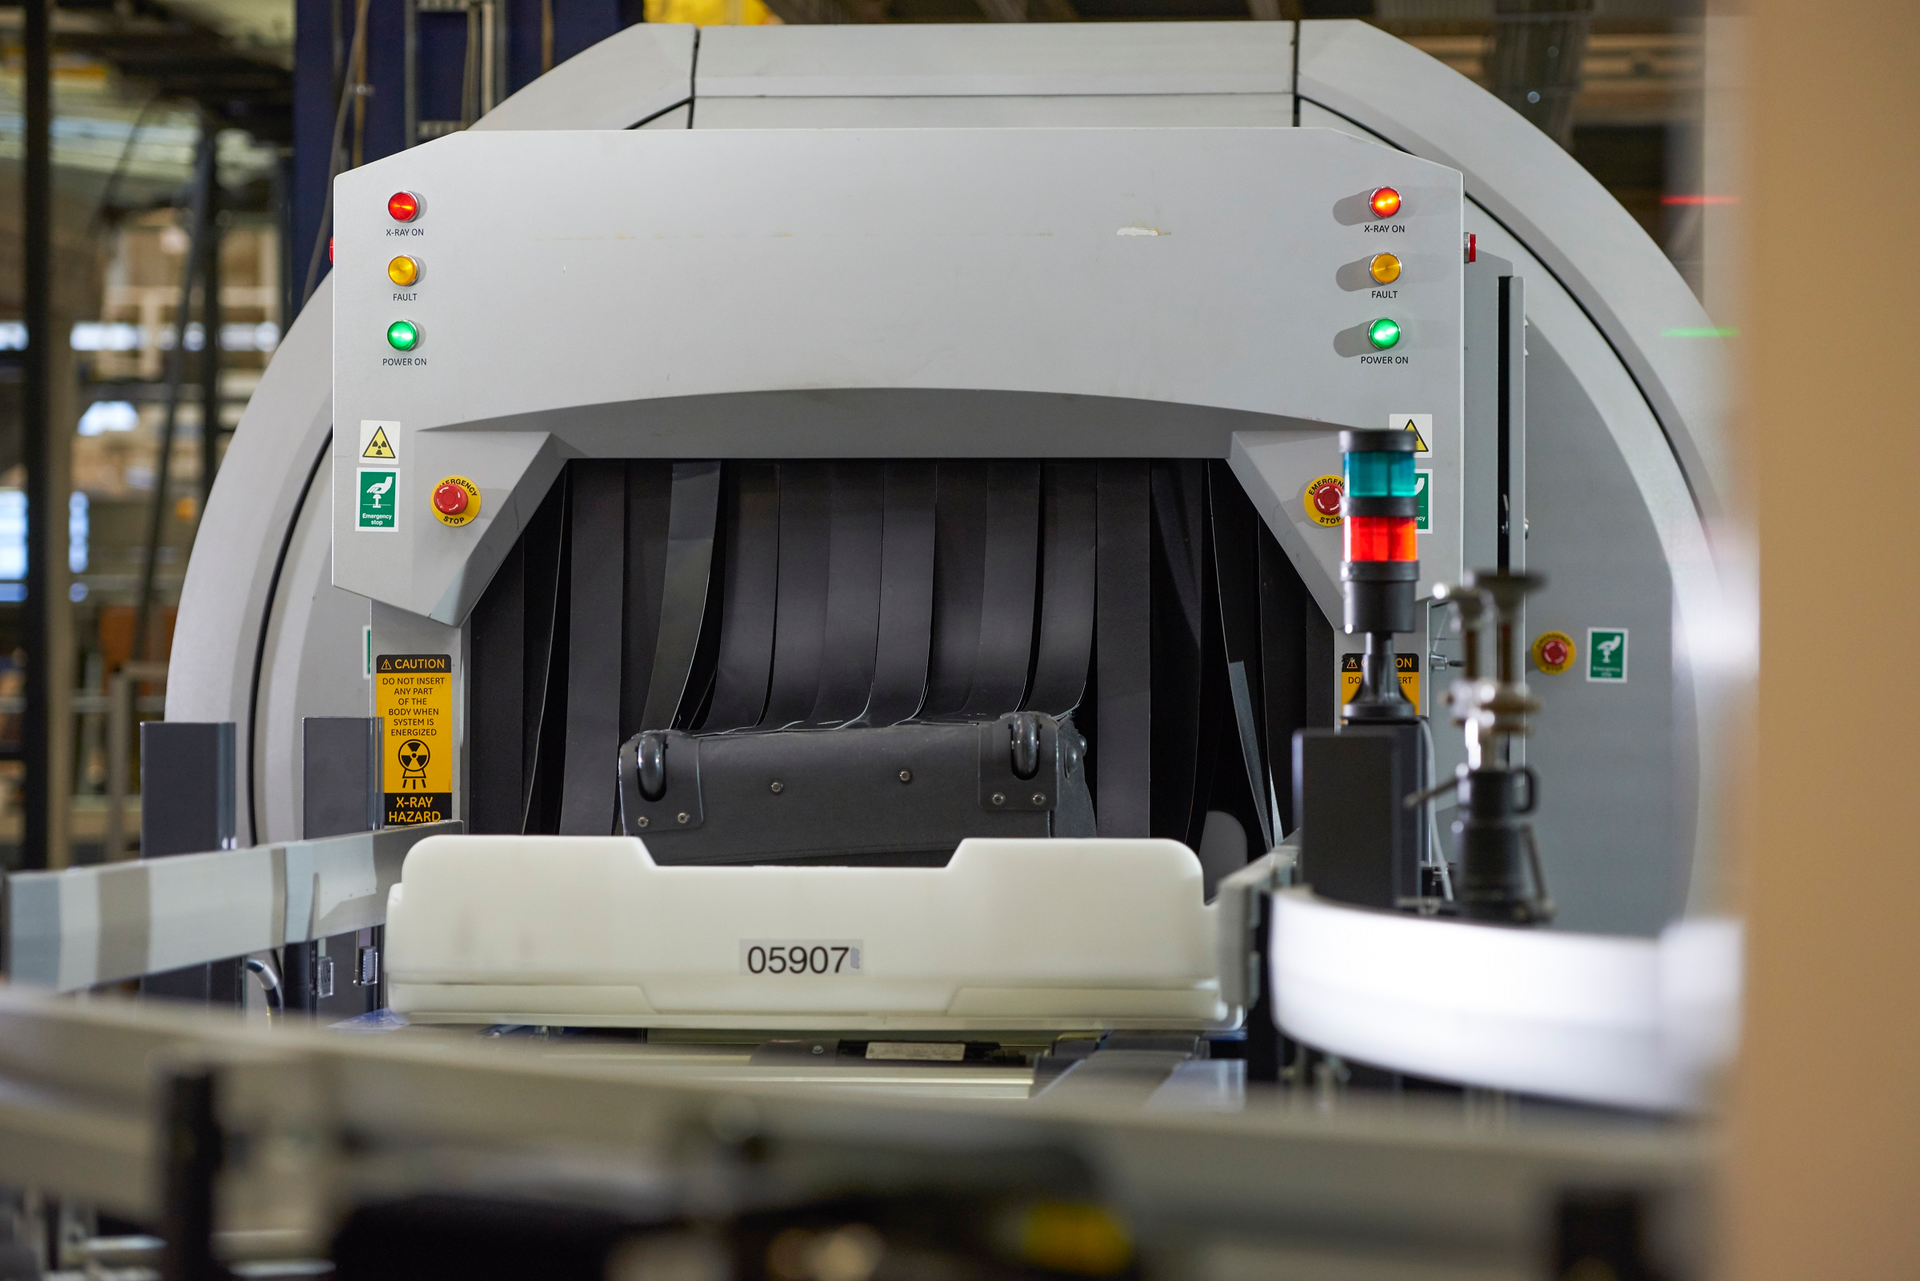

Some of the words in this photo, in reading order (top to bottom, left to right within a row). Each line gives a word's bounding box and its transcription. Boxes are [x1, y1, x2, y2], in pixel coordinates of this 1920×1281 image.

[386, 229, 410, 237] X-RAY
[1364, 225, 1390, 233] X-RAY
[1391, 225, 1405, 233] ON
[1371, 291, 1398, 299] FAULT
[382, 358, 413, 366] POWER
[414, 358, 427, 366] ON
[1360, 357, 1393, 365] POWER
[1395, 357, 1409, 365] ON
[439, 478, 477, 496] ERGENCY
[1309, 478, 1345, 496] EMERGEN
[362, 513, 392, 521] Emergency
[443, 516, 465, 524] STOP
[1319, 516, 1341, 524] STOP
[395, 658, 445, 669] CAUTION
[382, 677, 396, 685] DO
[397, 677, 415, 685] NOT
[416, 677, 445, 685] INSERT
[388, 708, 413, 716] BODY
[413, 708, 439, 716] WHEN
[393, 718, 425, 726] SYSTEM
[426, 718, 434, 726] IS
[396, 796, 433, 808] X-RAY
[388, 811, 441, 822] HAZARD
[747, 946, 850, 974] 05907
